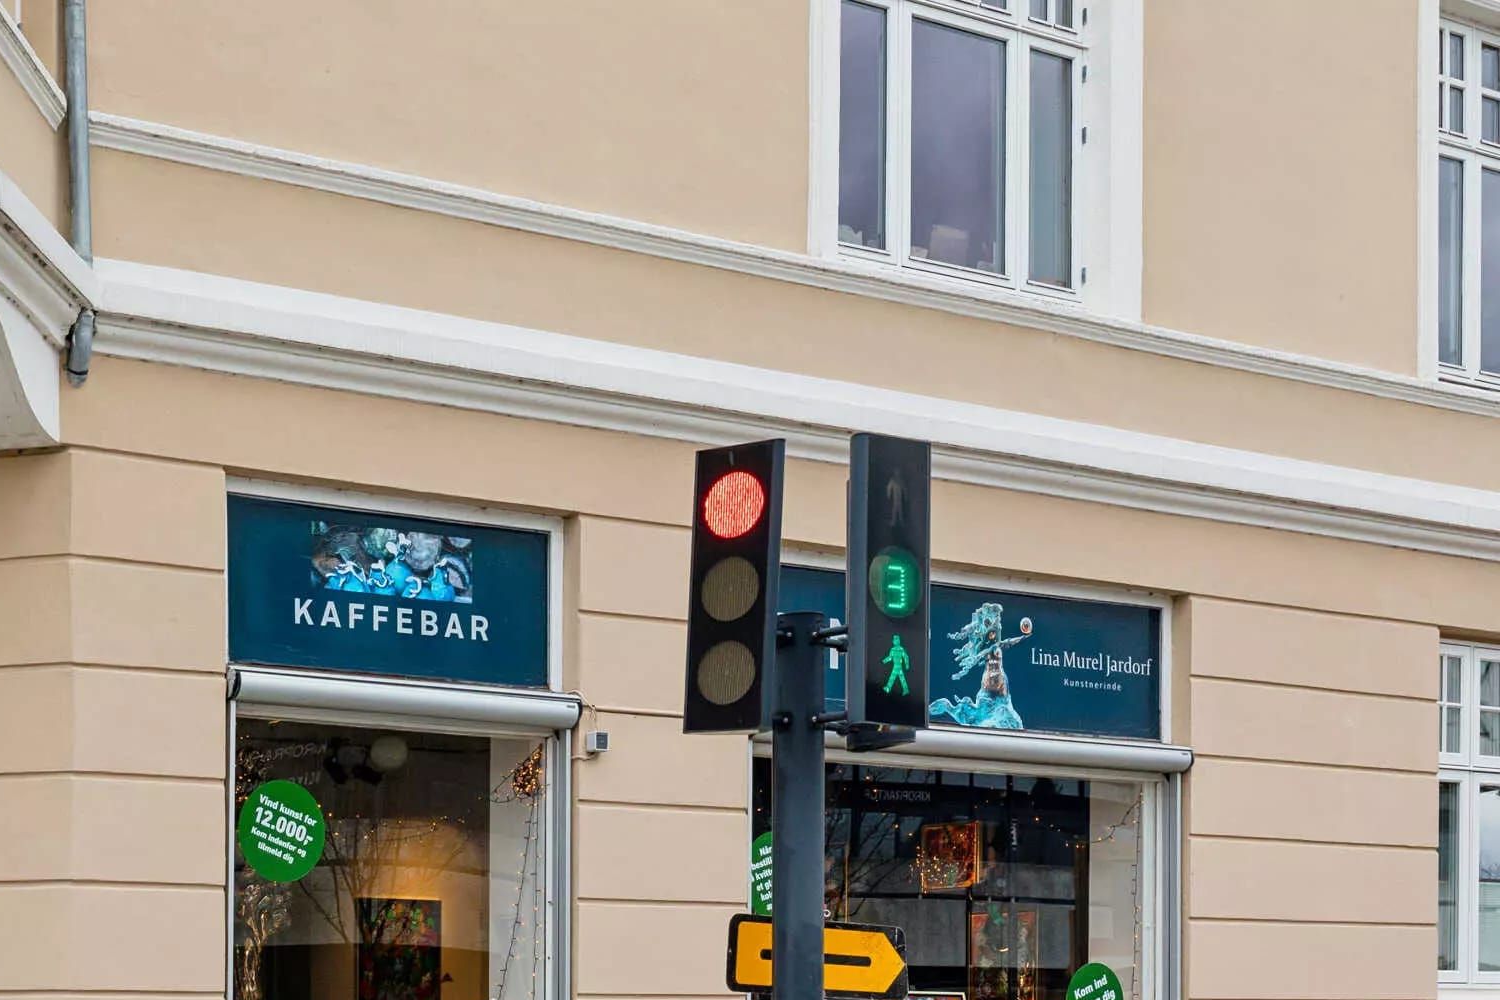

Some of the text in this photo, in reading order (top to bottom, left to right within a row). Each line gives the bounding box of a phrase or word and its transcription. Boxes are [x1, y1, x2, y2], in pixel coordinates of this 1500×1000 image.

[887, 565, 905, 609] 3
[295, 597, 490, 642] KAFFEBAR
[1031, 647, 1153, 677] Lina Murel Jardorf
[1063, 678, 1122, 691] Kunstnerinde
[260, 793, 317, 827] Vind kunst for
[251, 826, 307, 858] Kom indenfor og
[257, 841, 294, 865] tilmeld dig
[1074, 974, 1108, 1000] Kom ind
